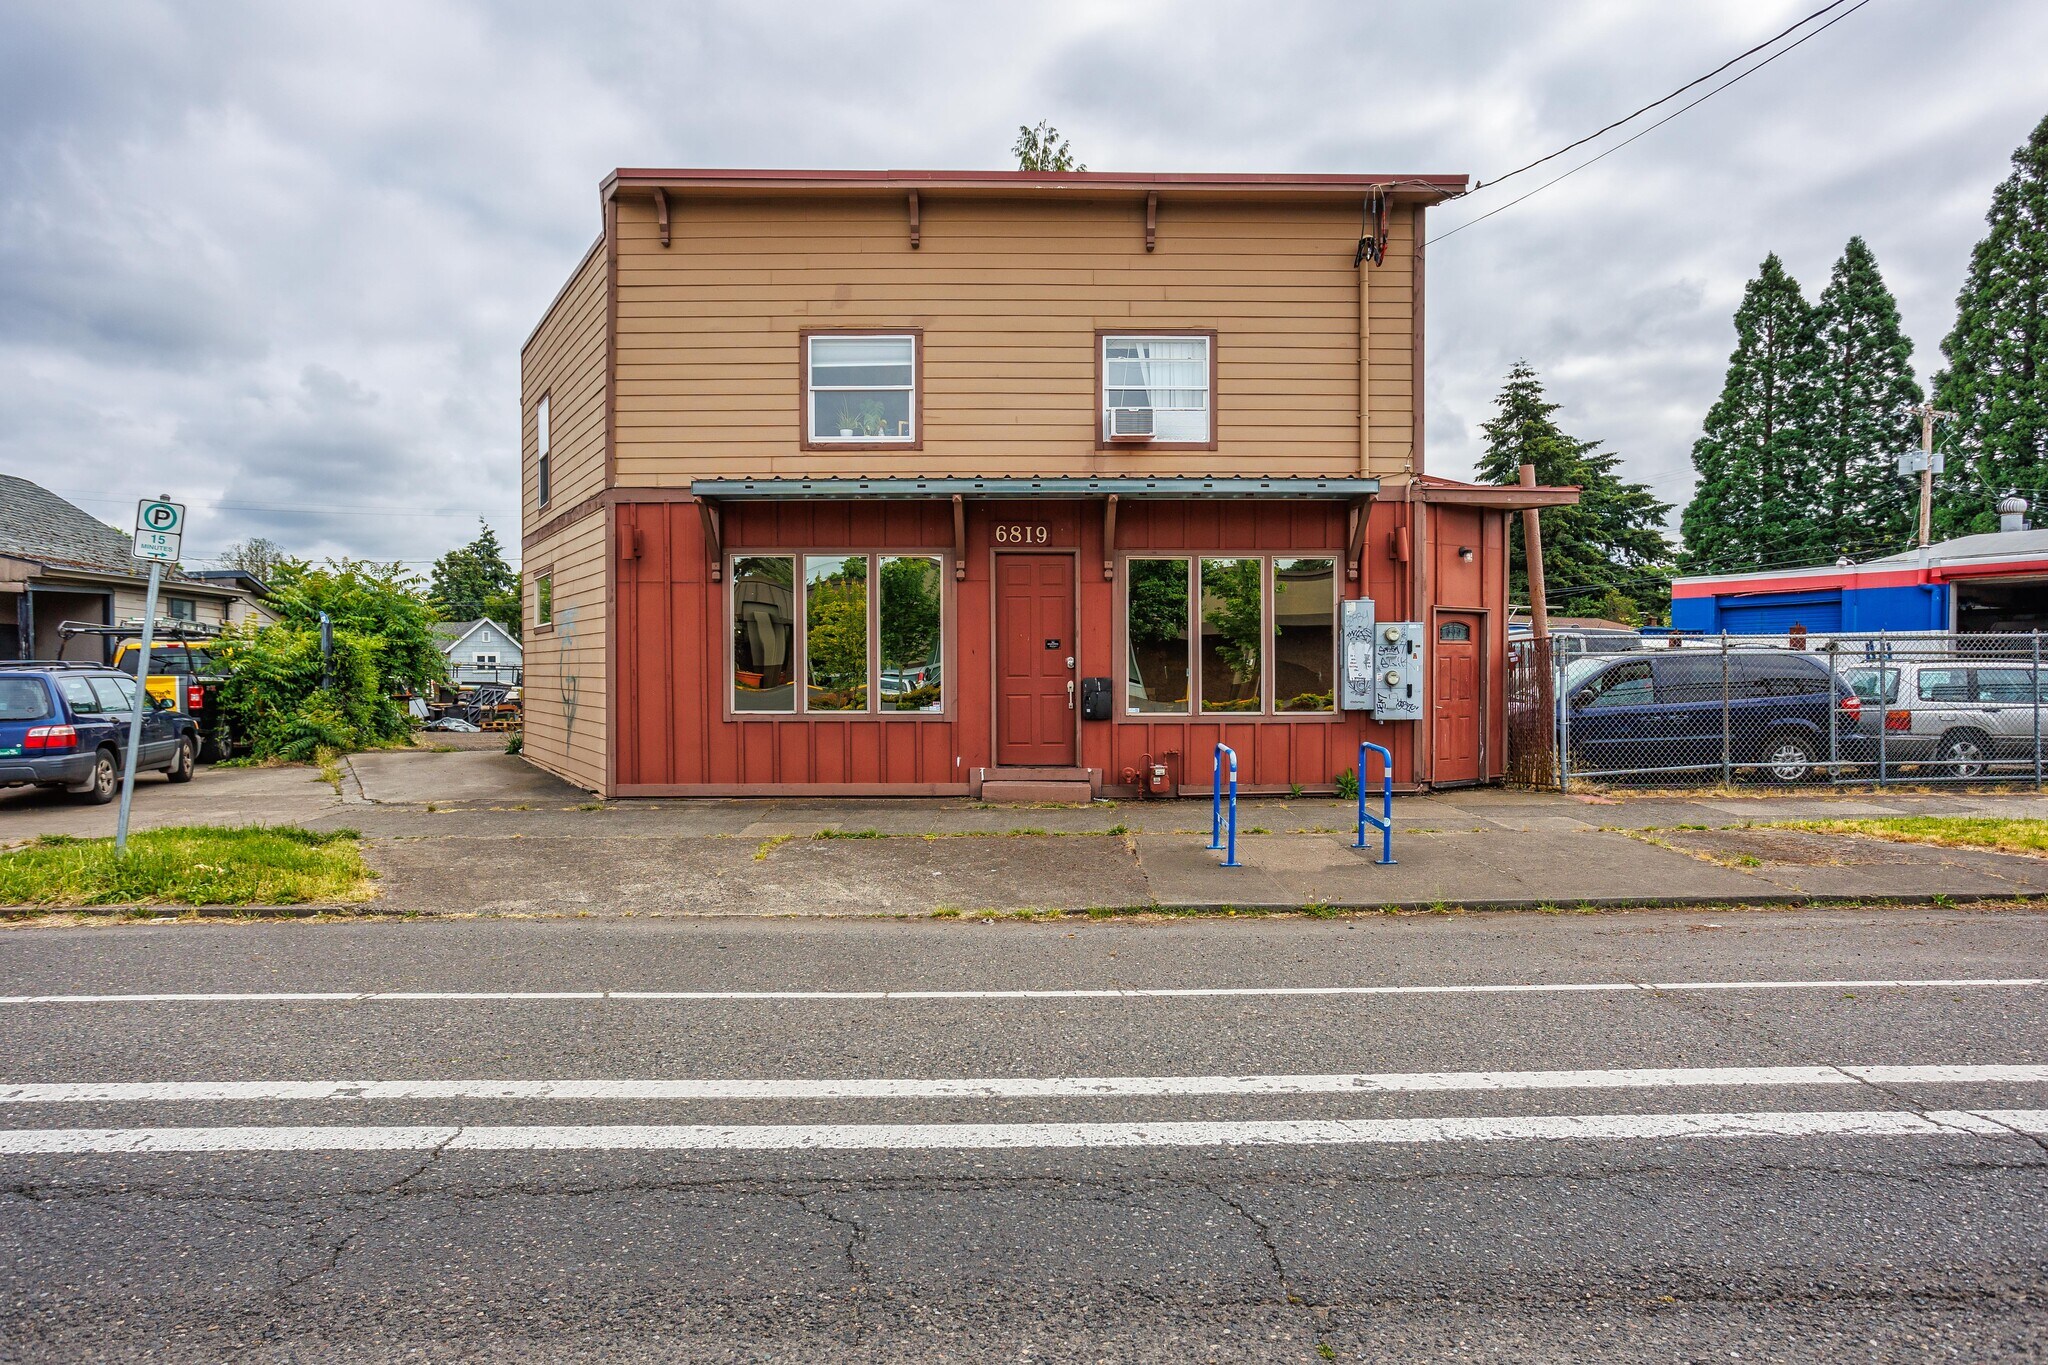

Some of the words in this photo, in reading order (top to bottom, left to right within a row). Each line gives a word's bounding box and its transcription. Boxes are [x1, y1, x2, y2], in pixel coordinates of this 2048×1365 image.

[154, 509, 170, 525] P
[151, 535, 166, 544] 15
[996, 525, 1047, 543] 6819
[141, 544, 173, 552] MINUTES
